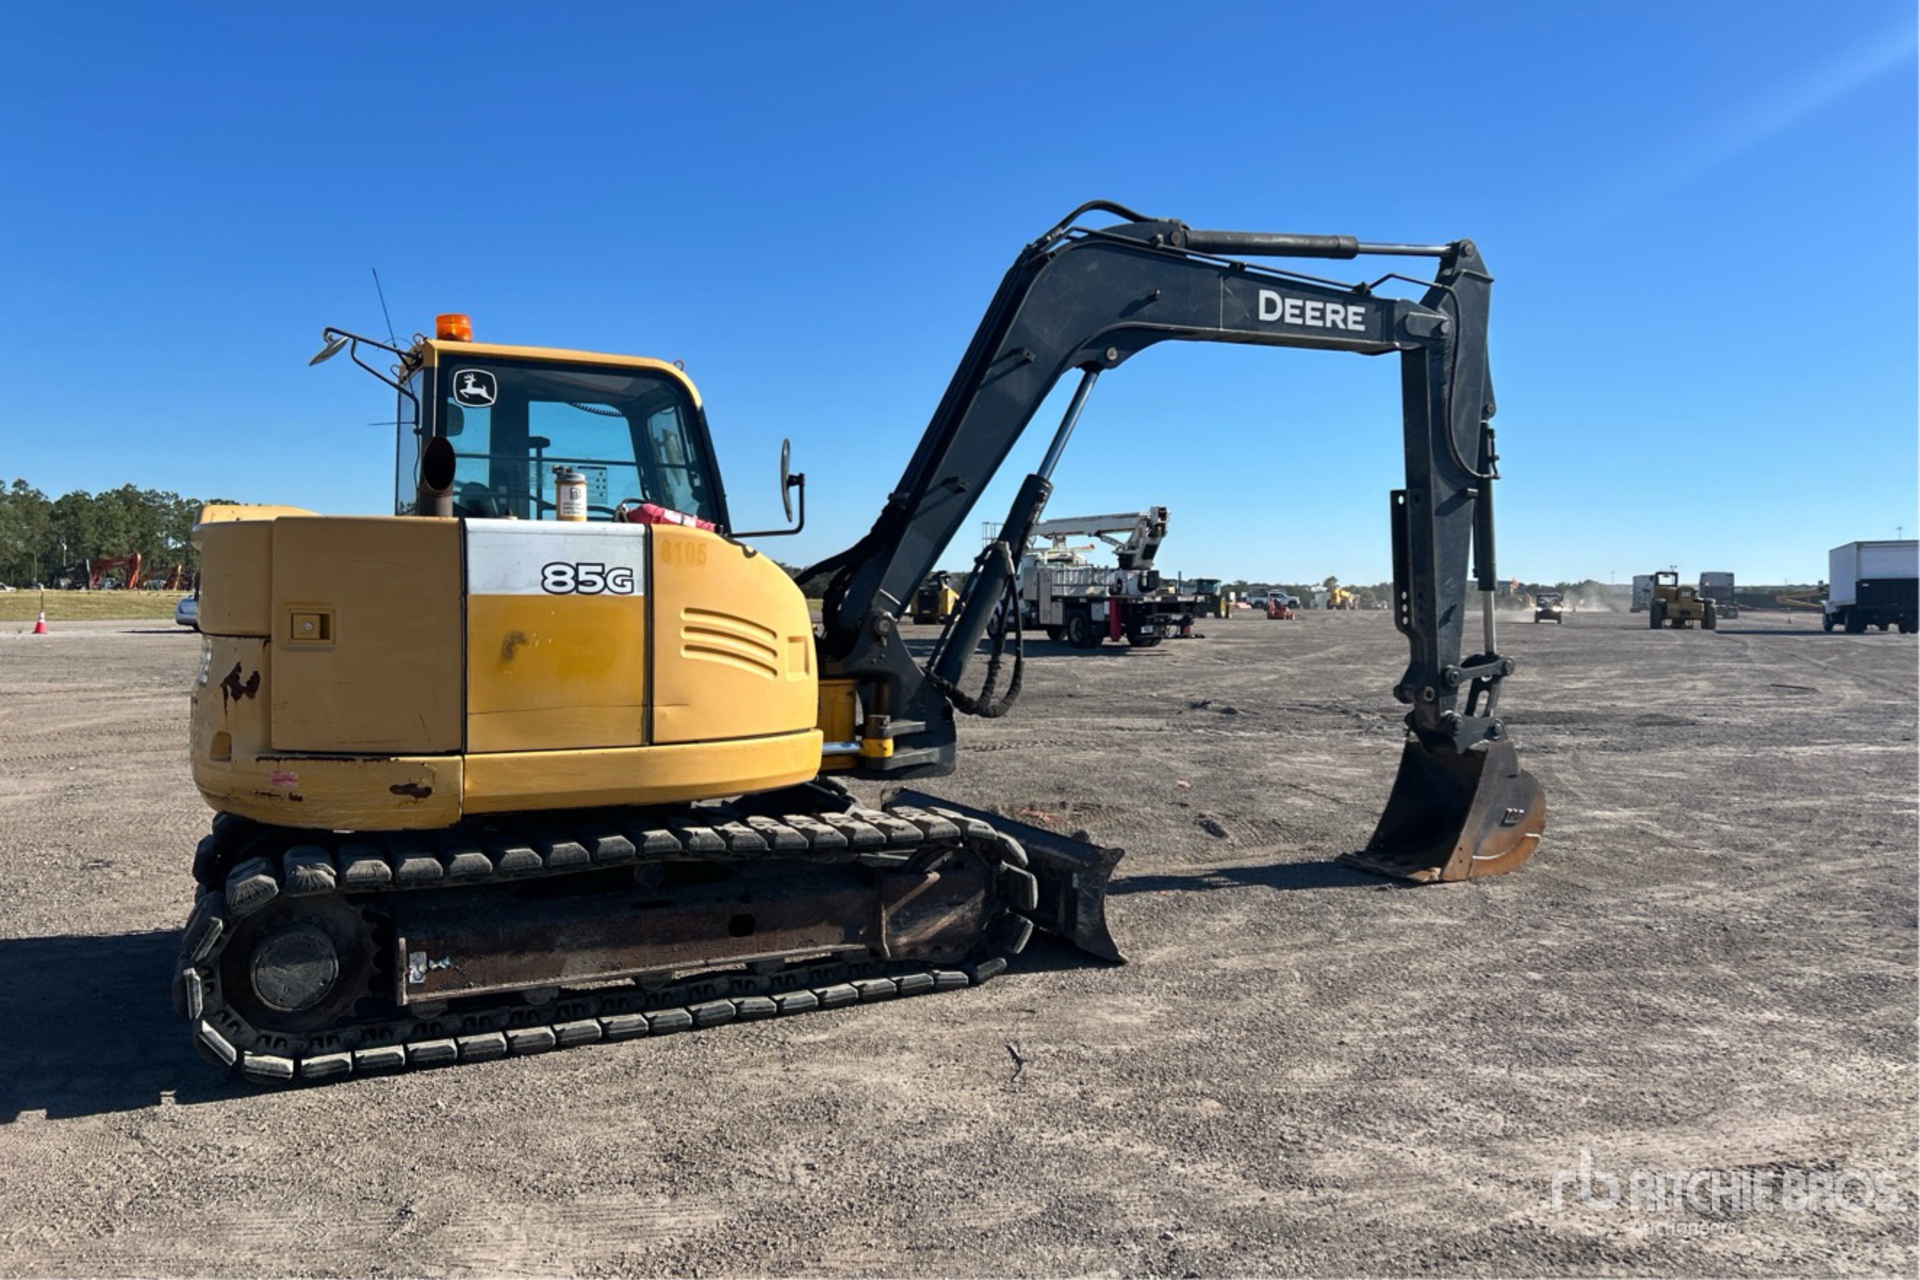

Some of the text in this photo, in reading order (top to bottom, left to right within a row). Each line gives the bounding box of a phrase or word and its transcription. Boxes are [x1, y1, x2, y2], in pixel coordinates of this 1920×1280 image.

[1259, 289, 1366, 331] DEERE
[660, 539, 707, 565] 8105
[541, 562, 634, 595] 85G
